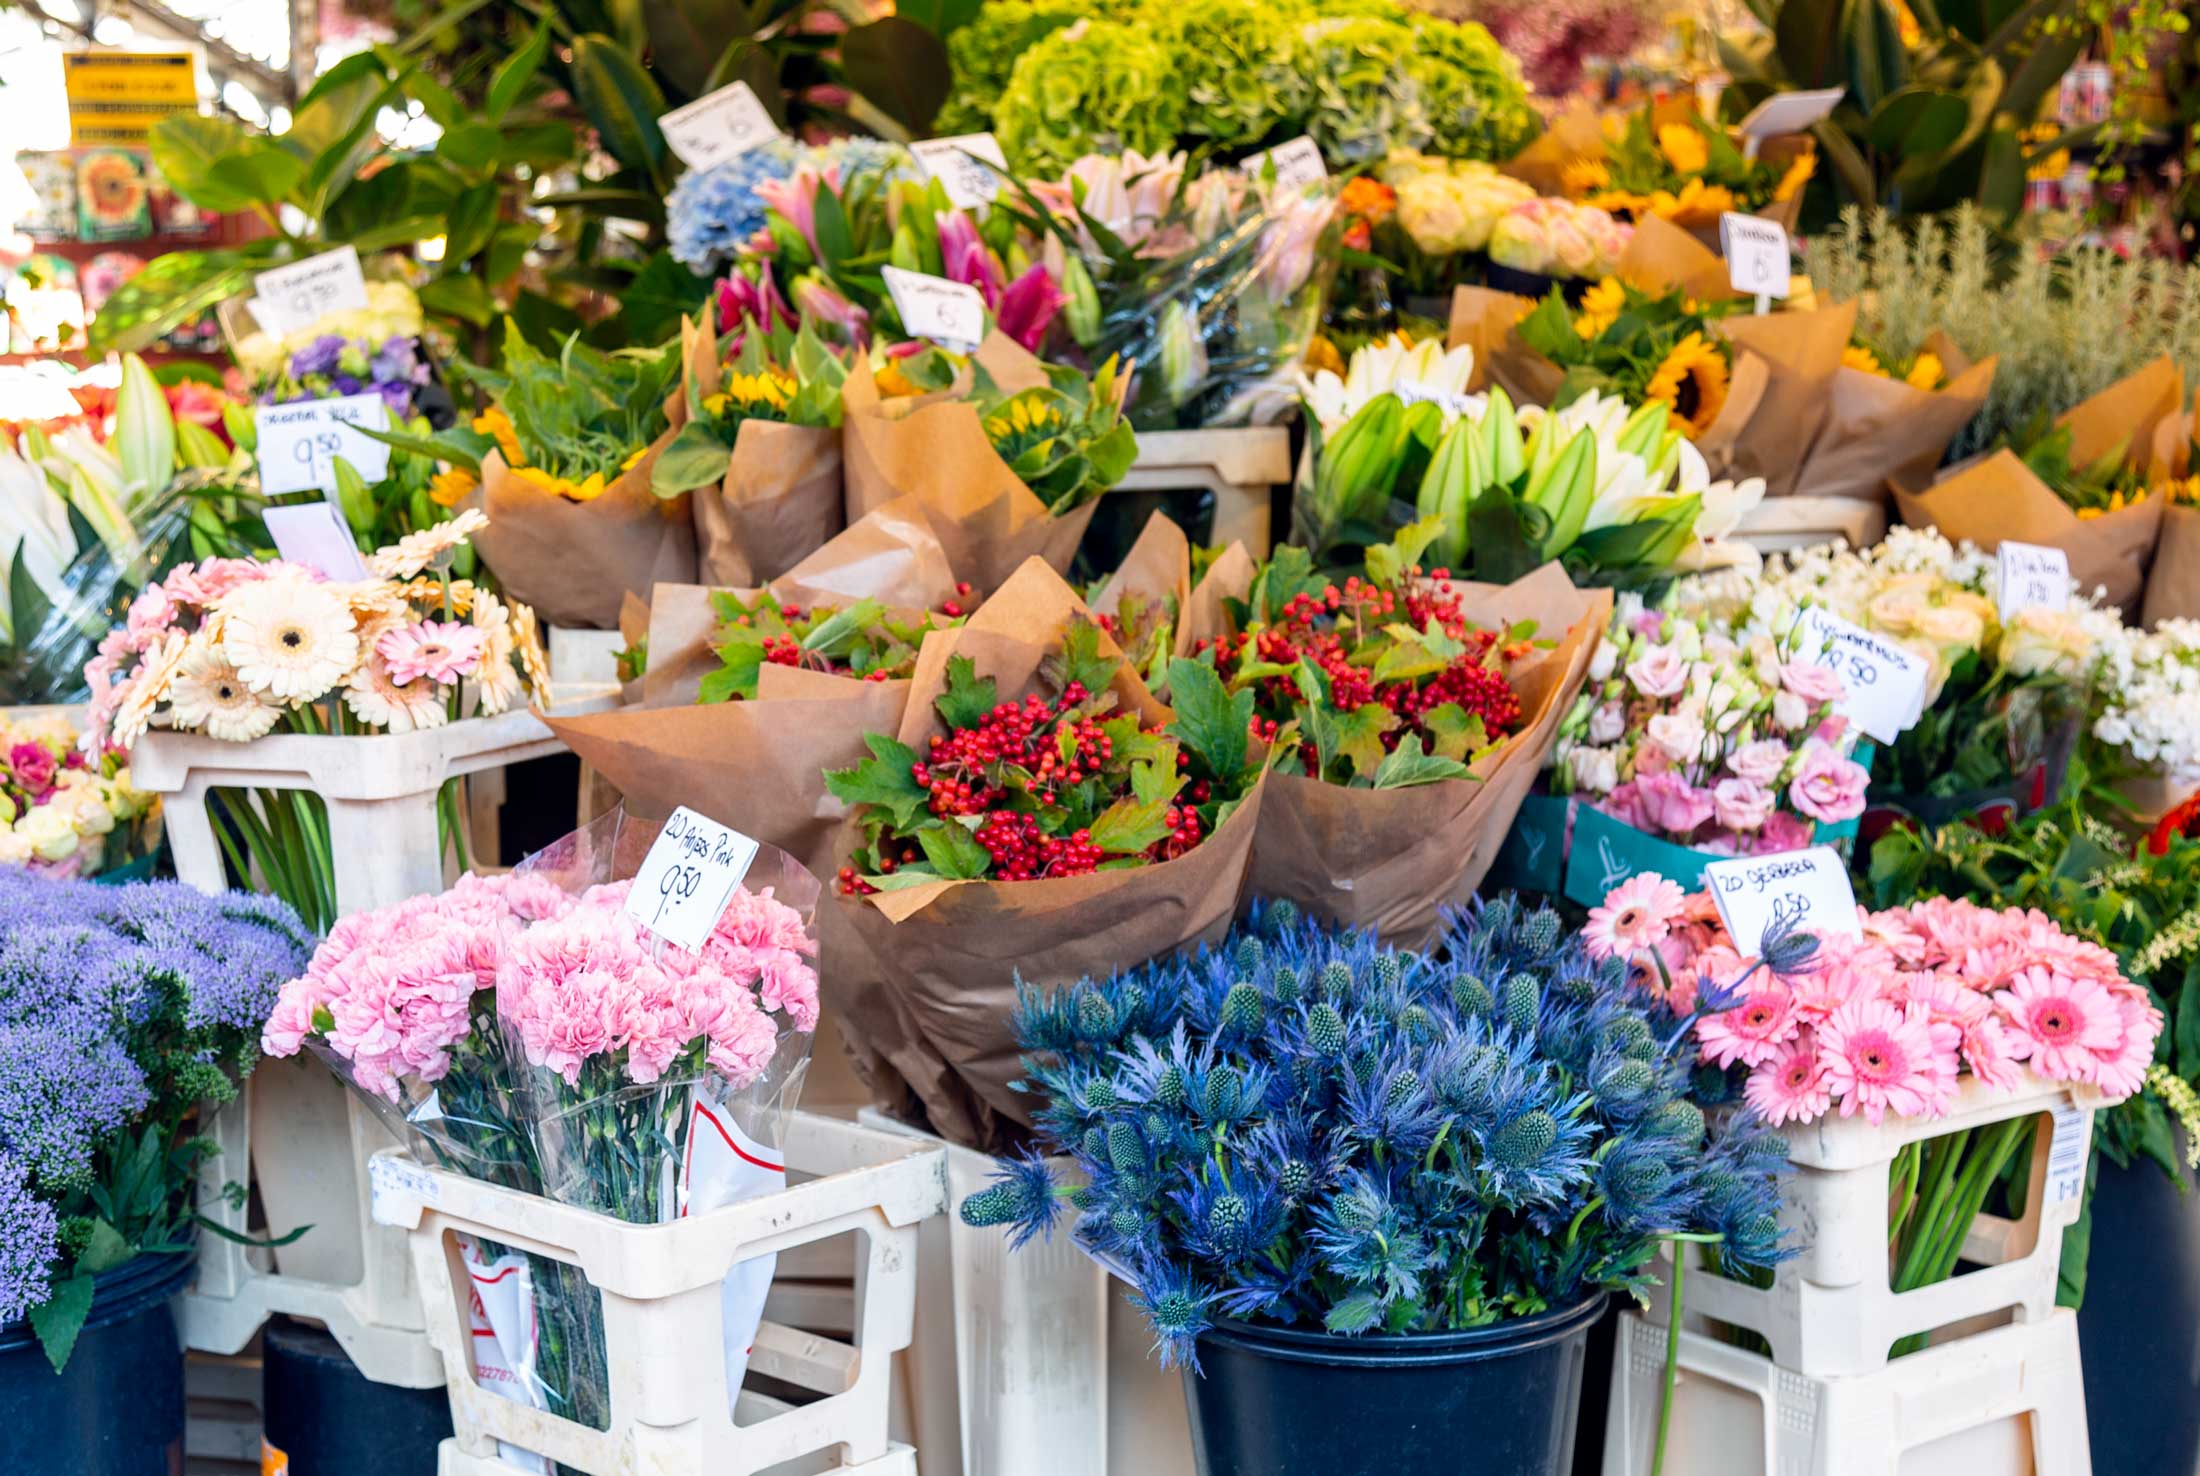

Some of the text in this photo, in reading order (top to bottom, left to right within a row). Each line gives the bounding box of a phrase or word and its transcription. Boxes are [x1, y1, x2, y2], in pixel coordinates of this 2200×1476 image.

[665, 813, 688, 839] 20
[709, 832, 734, 868] Pink
[1719, 874, 1744, 893] 20
